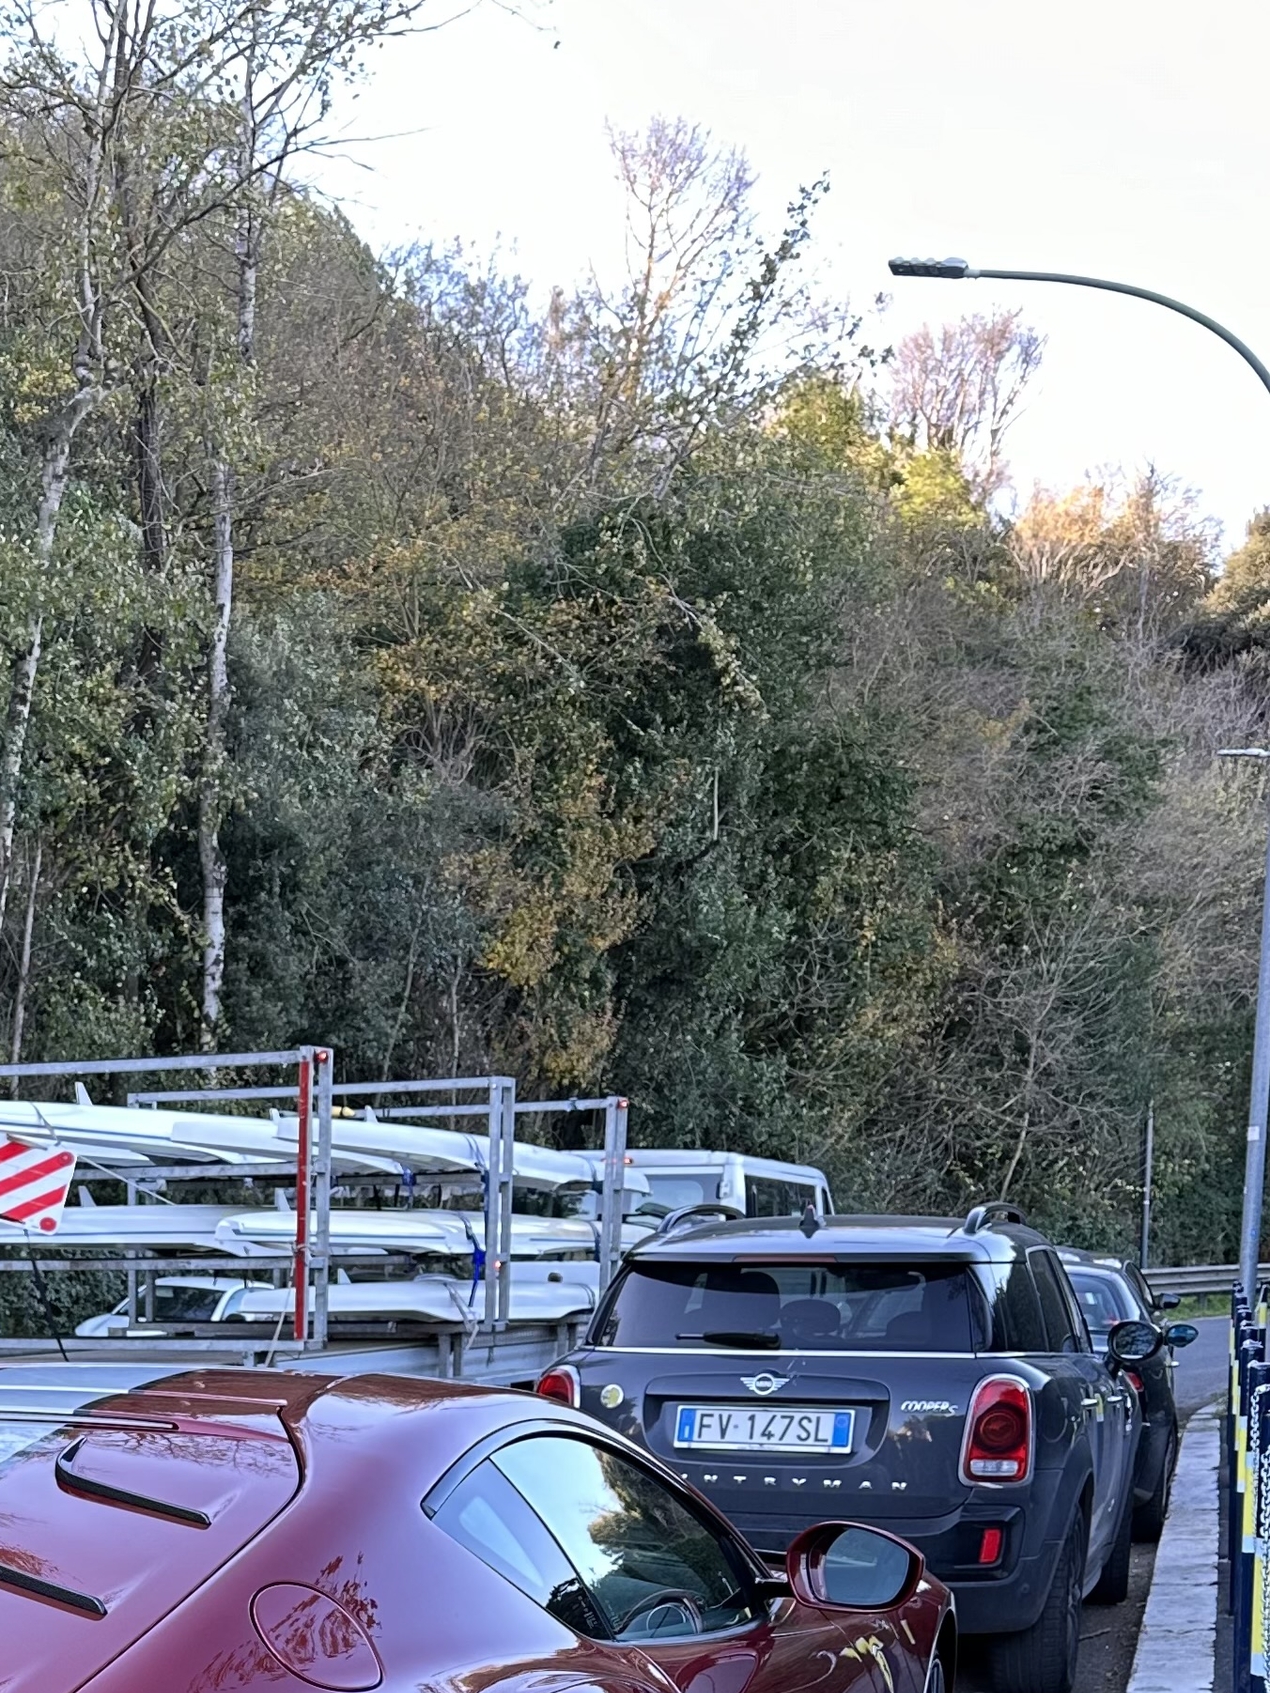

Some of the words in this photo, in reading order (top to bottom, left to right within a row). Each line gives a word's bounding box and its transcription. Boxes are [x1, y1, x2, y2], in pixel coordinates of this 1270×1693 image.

[900, 1400, 949, 1412] COOPER
[944, 1404, 959, 1418] S
[697, 1413, 732, 1440] FV
[747, 1414, 829, 1443] 147SL
[681, 1473, 908, 1490] NTRYMAN
